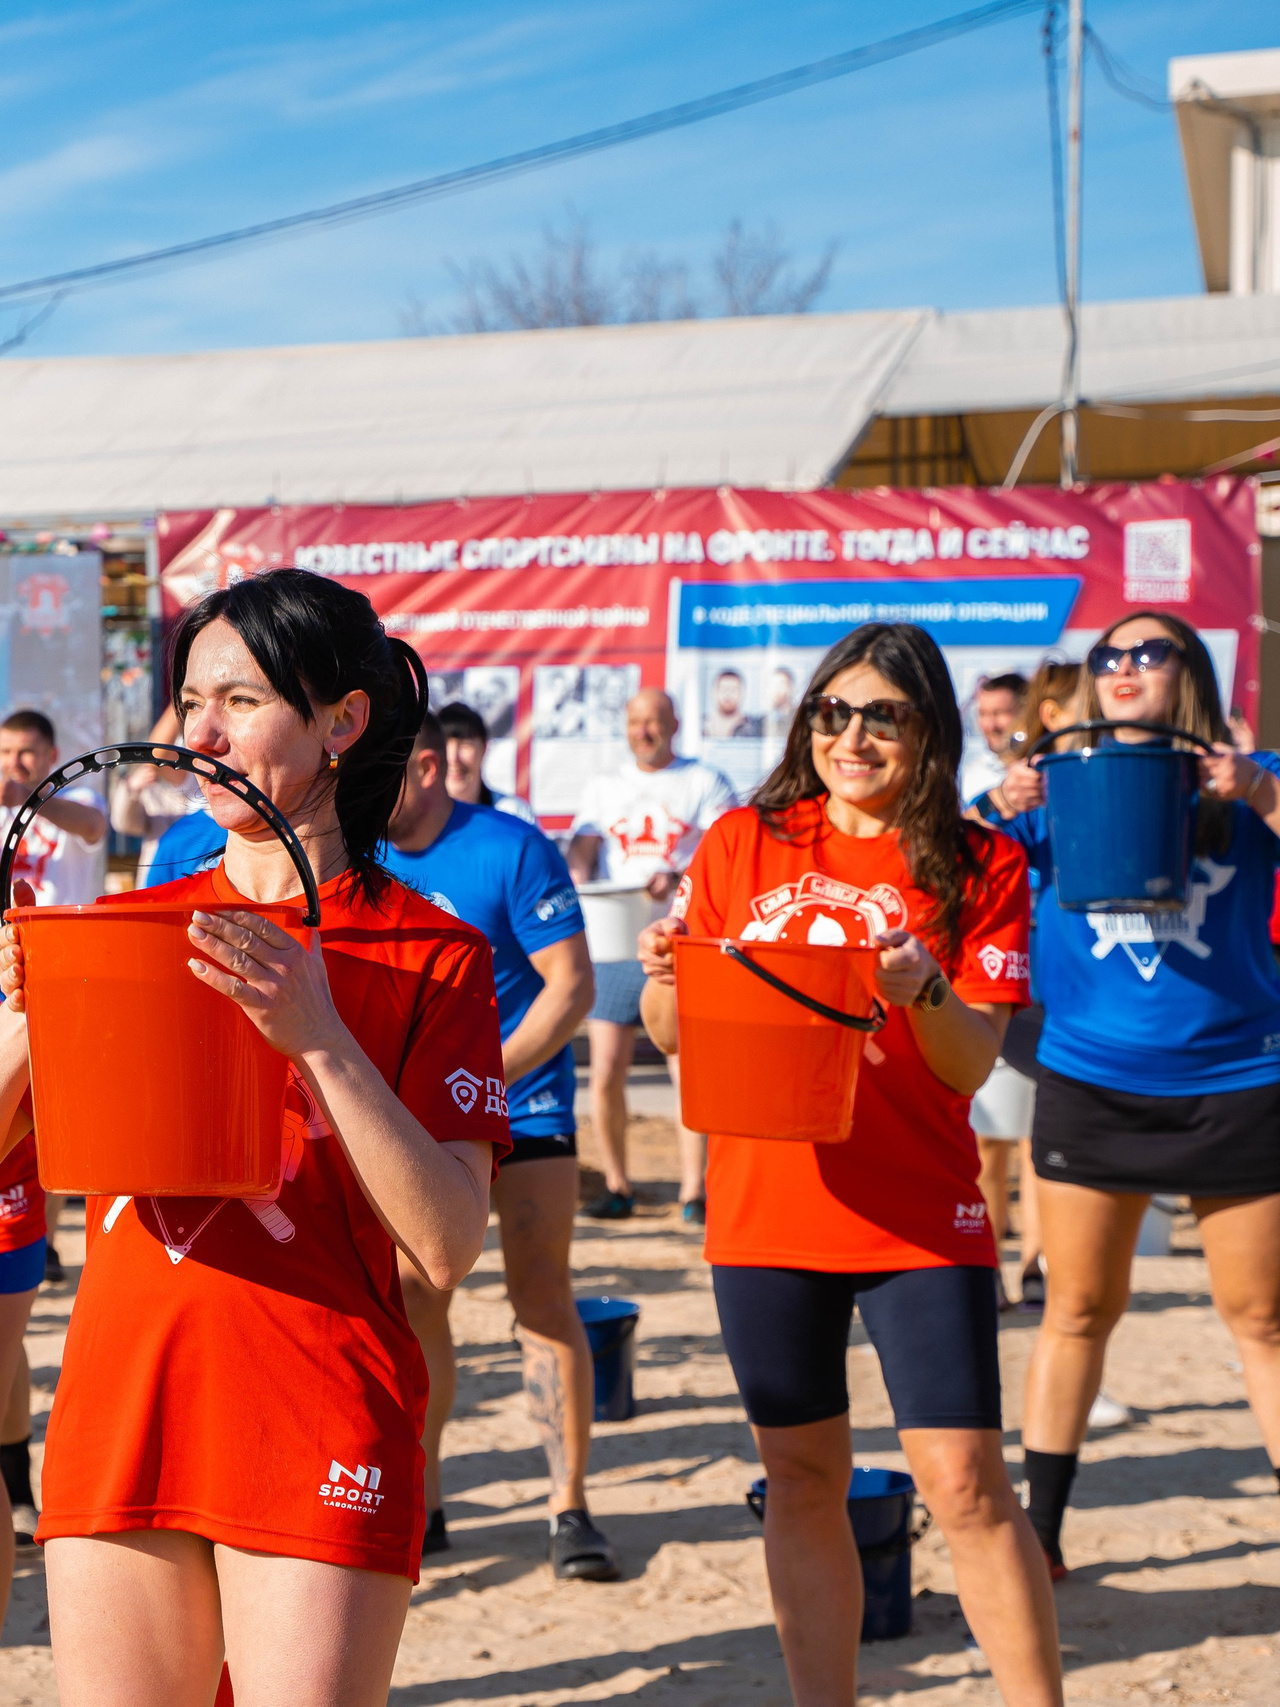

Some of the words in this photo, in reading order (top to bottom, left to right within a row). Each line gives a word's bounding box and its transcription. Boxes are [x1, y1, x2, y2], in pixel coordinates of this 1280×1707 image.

[461, 532, 659, 570] СПОРТСМЕНЫ
[662, 531, 705, 563] НА
[706, 528, 836, 566] ФРОНТЕ.
[839, 527, 935, 566] ТОГДА
[937, 527, 964, 559] И
[966, 519, 1090, 560] СЕЙЧАС
[486, 1076, 507, 1098] ПУ
[484, 1094, 509, 1117] ДО
[953, 1219, 985, 1228] SPORT
[318, 1484, 385, 1507] SPORT
[323, 1500, 378, 1515] LABORATORY
